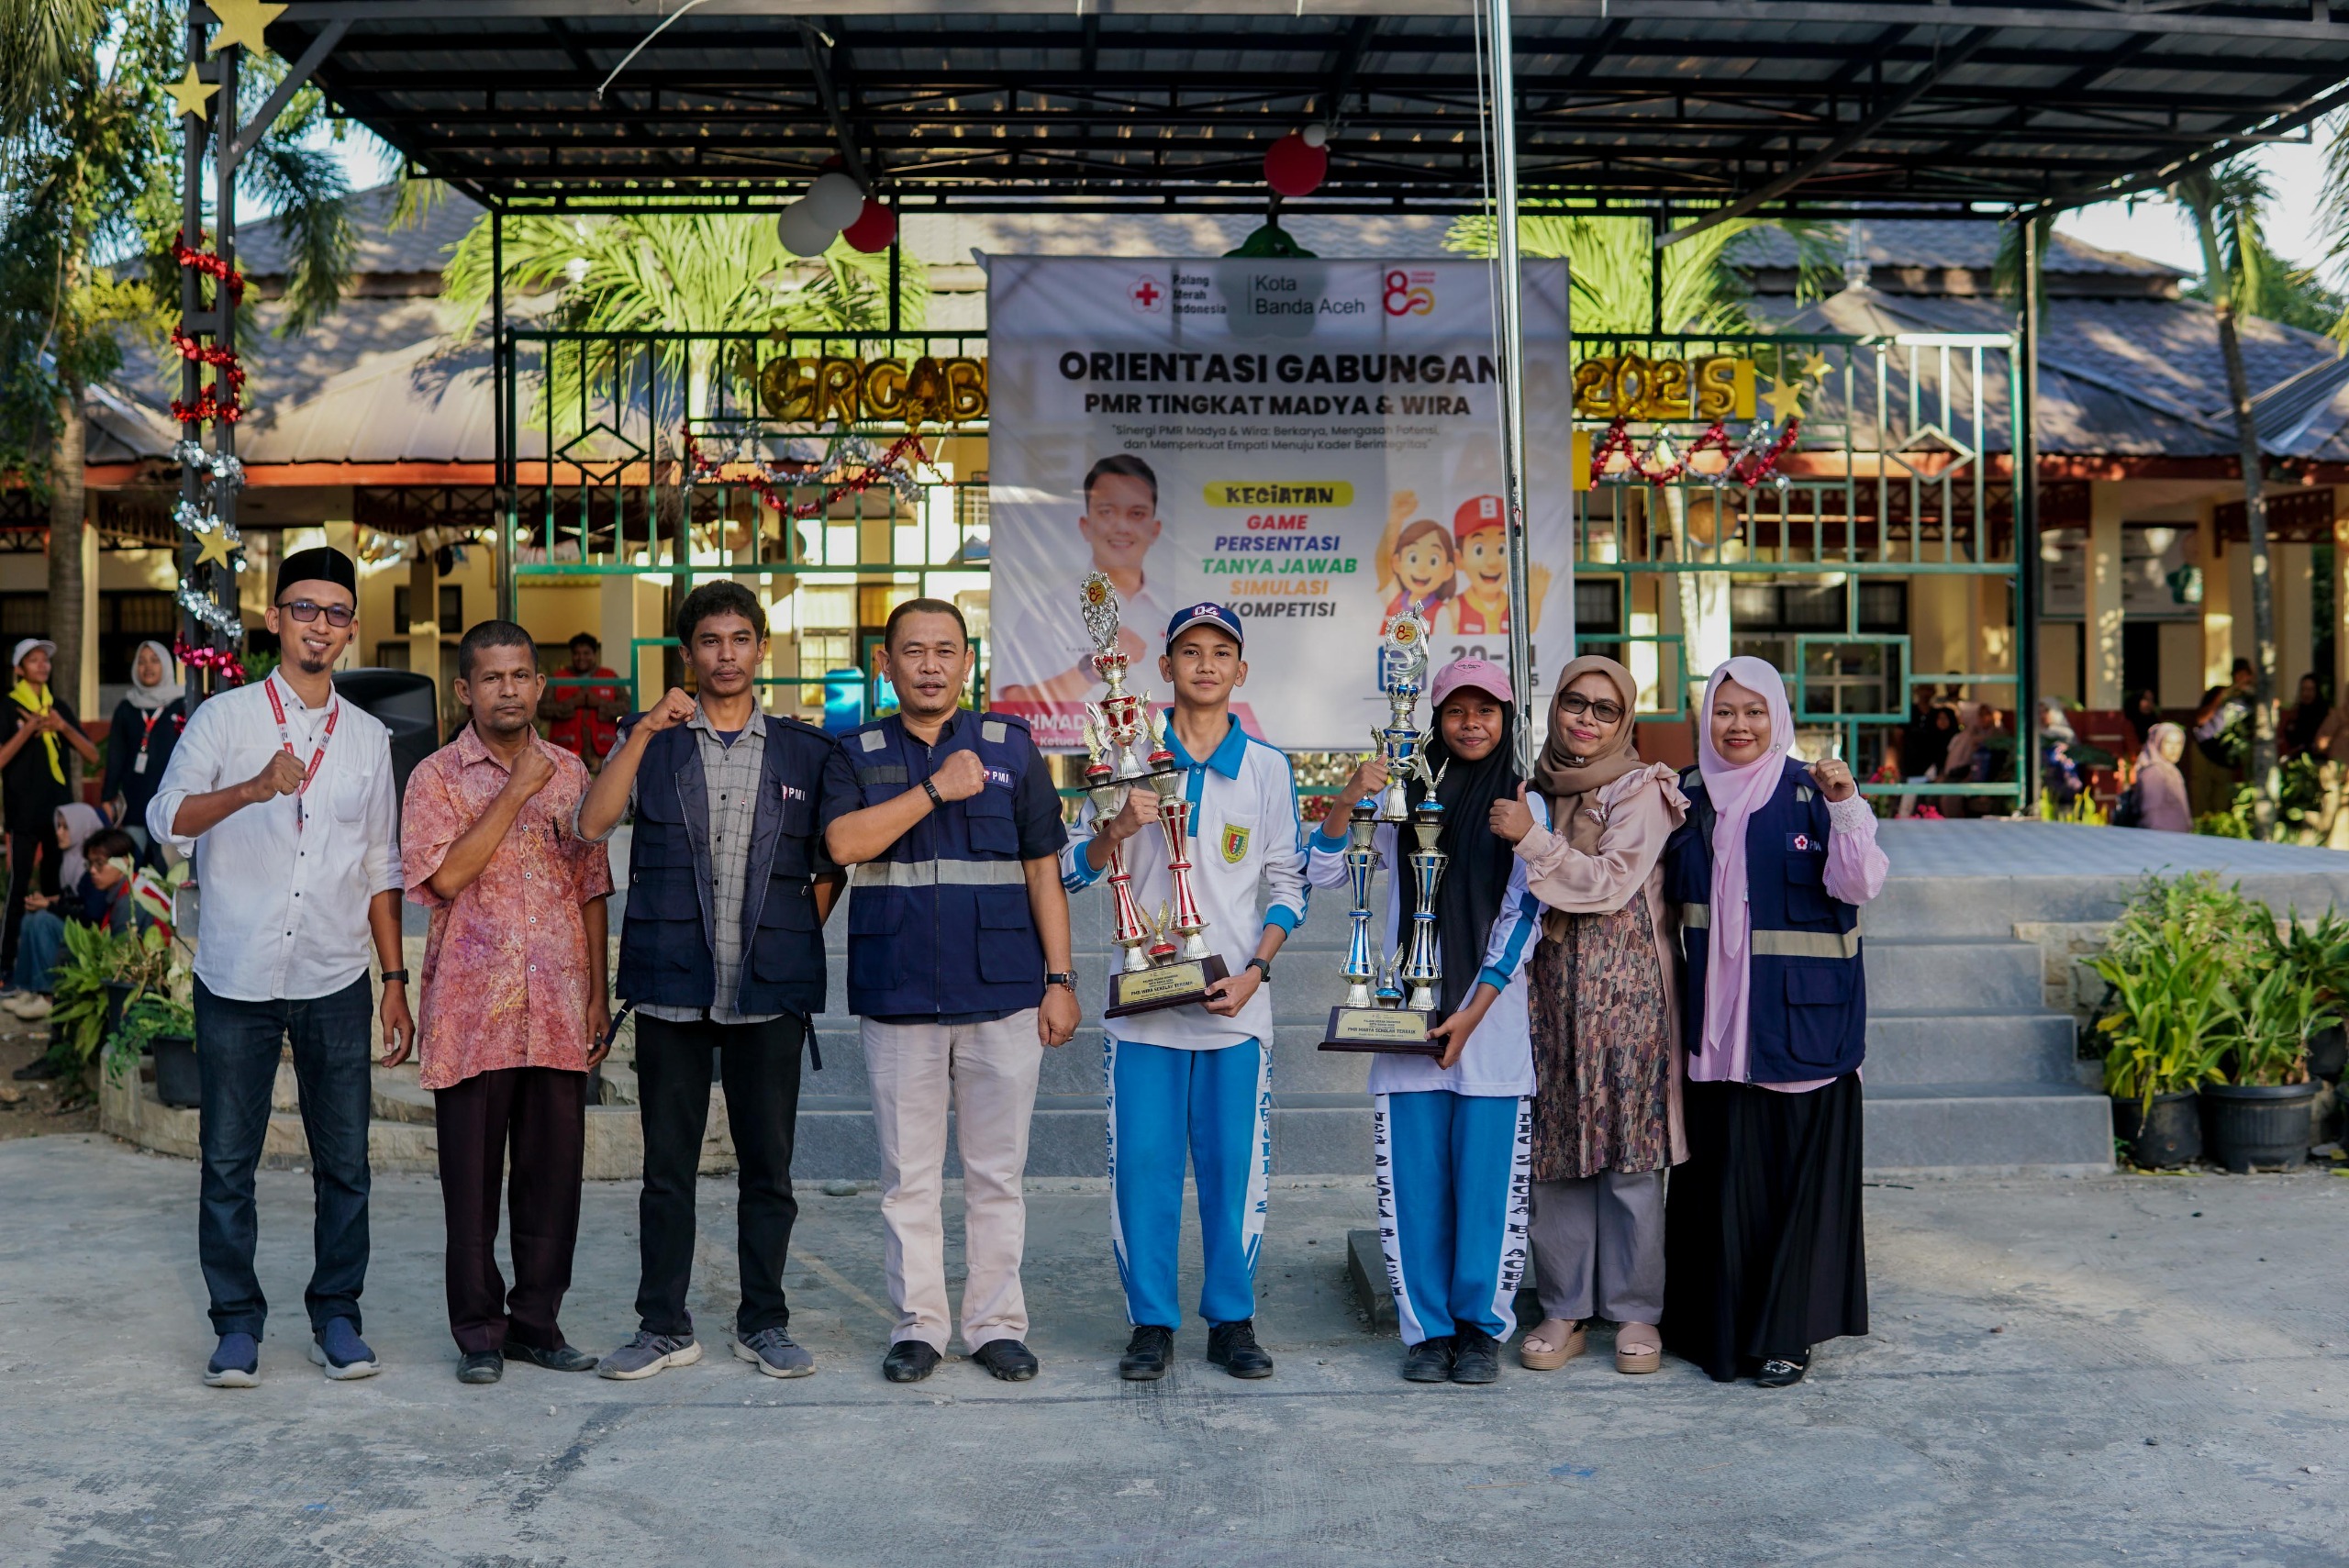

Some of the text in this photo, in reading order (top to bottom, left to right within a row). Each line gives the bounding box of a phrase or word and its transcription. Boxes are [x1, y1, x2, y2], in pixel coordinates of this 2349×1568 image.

[1173, 274, 1209, 287] Palang
[1255, 275, 1297, 292] Kota
[1173, 289, 1206, 299] Merah
[1173, 303, 1227, 314] Indonesia
[1255, 298, 1365, 314] Banda Aceh
[1059, 351, 1503, 384] ORIENTASI GABUNGAN
[1574, 354, 1736, 418] 2025
[1085, 394, 1471, 415] PMR TINGKAT MADYA & WIRA
[1158, 425, 1183, 436] PMR
[1186, 425, 1226, 438] Madya
[1229, 425, 1238, 436] &
[1331, 426, 1393, 438] Mengasah
[1123, 439, 1147, 450] dan
[1150, 439, 1224, 451] Memperkuat
[1228, 440, 1268, 452] Empati
[1272, 440, 1314, 452] Menuju
[1318, 440, 1351, 450] Kader
[1247, 514, 1308, 530] GAME
[1214, 536, 1341, 551] PERSENTASI
[1202, 558, 1357, 573] TANYA JAWAB
[1230, 580, 1329, 595] SIMULASI
[1040, 737, 1074, 747] Ketua
[993, 771, 1009, 783] PMI
[789, 788, 805, 801] PMI
